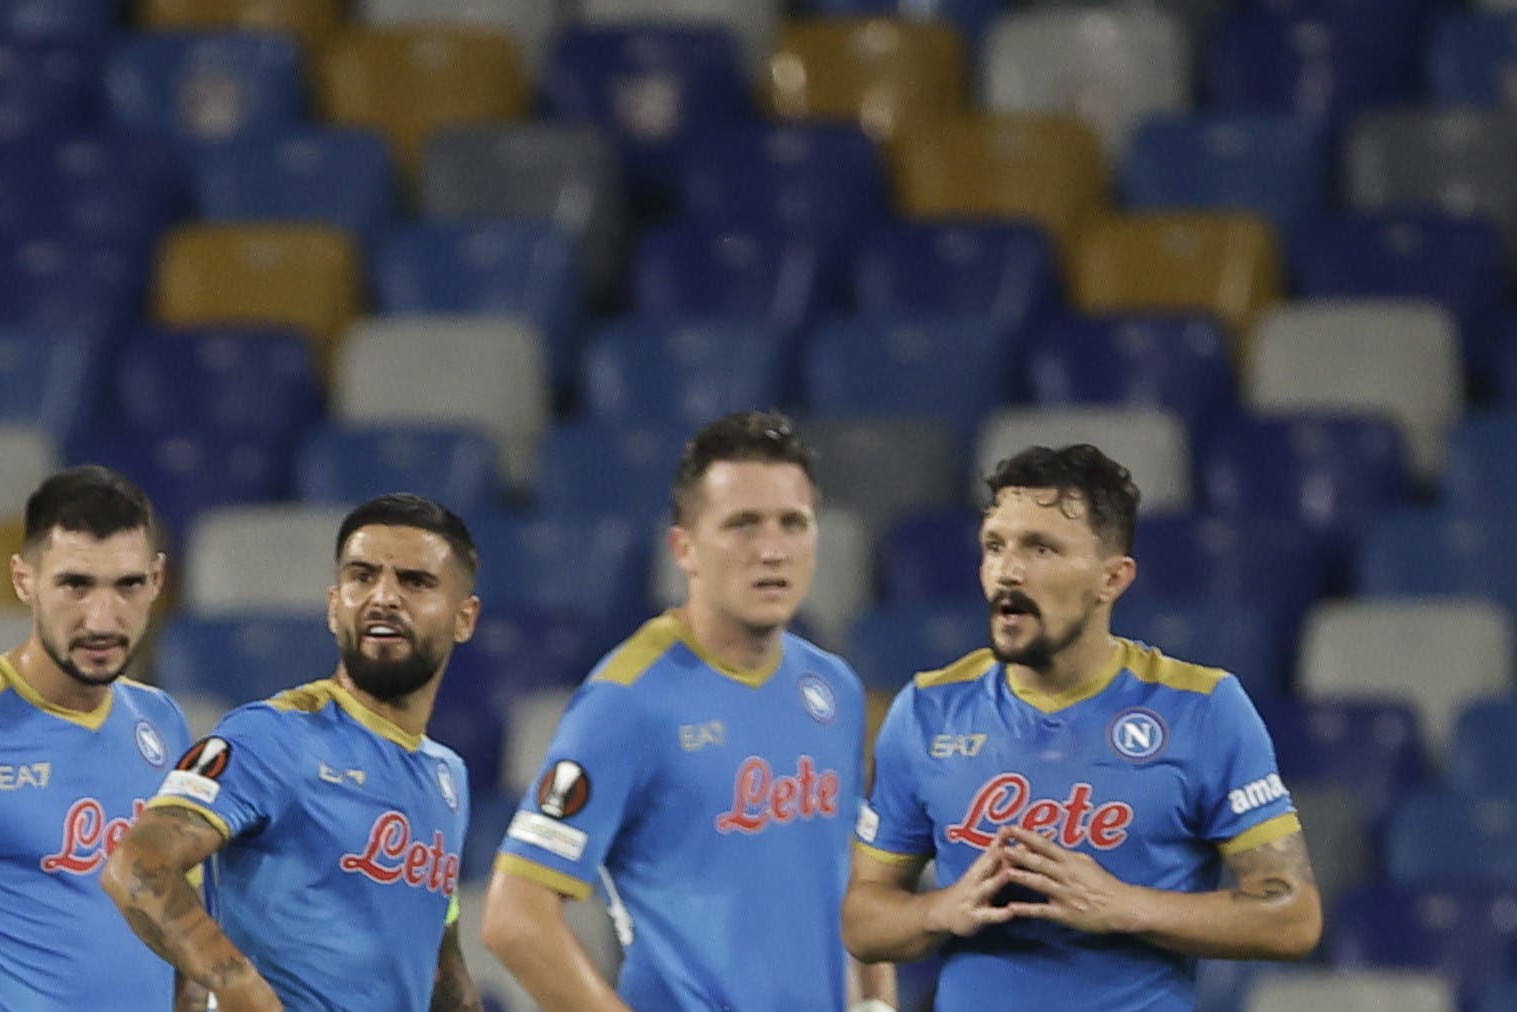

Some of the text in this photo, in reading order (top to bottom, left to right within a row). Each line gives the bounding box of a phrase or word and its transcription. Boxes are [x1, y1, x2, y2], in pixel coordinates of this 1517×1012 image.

[931, 733, 989, 758] EA7
[715, 755, 841, 834] Lete
[946, 772, 1134, 849] Lete
[340, 810, 461, 898] Lete
